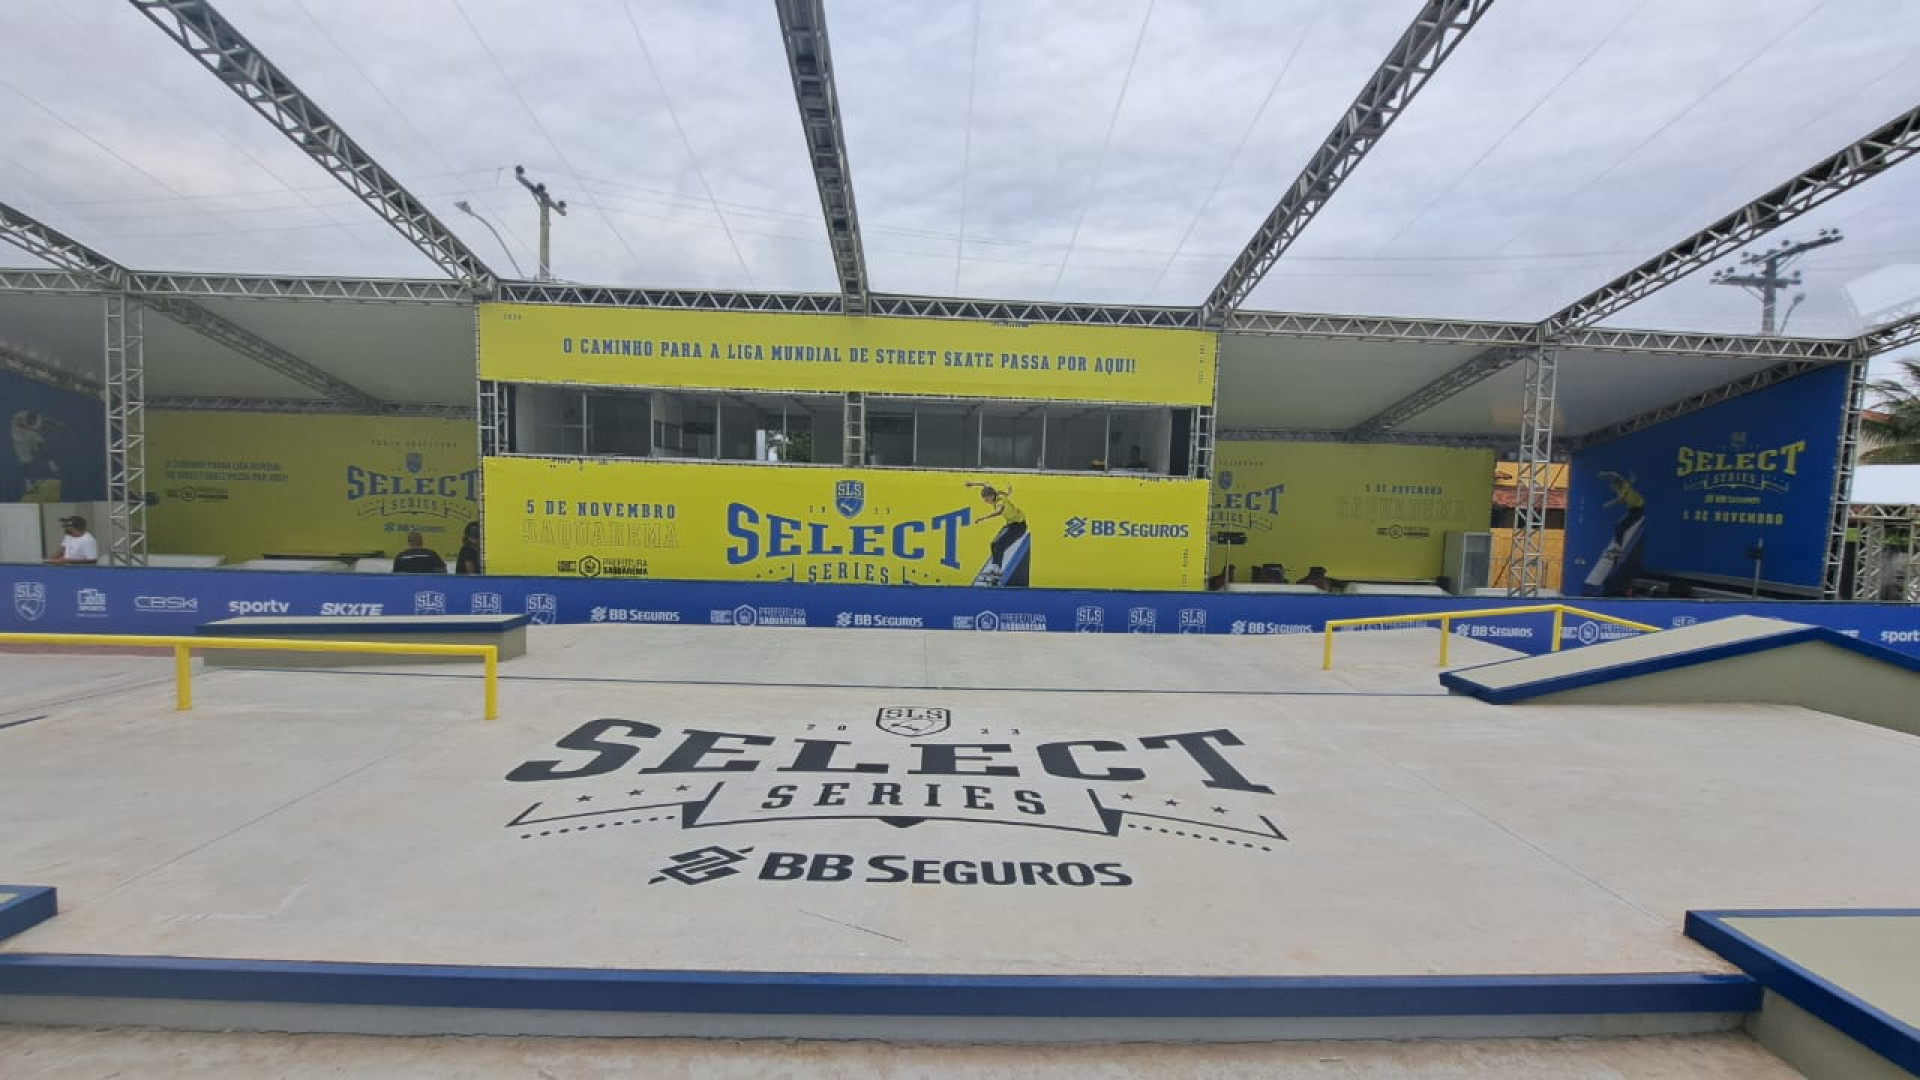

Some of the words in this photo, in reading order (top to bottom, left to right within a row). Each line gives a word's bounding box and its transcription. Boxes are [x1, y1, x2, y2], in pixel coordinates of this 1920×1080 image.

[563, 338, 573, 353] O
[580, 338, 653, 356] CAMINHO
[660, 341, 702, 358] PARA
[710, 343, 720, 359] A
[728, 344, 764, 361] LIGA
[771, 345, 842, 363] MUNDIAL
[850, 347, 869, 363] DE
[875, 348, 937, 366] STREET
[944, 350, 994, 368] SKATE
[1001, 353, 1050, 370] PASSA
[1057, 356, 1087, 372] POR
[1094, 356, 1136, 374] AQUI!
[1676, 441, 1806, 478] SELECT
[347, 465, 480, 501] SELECT
[837, 482, 863, 496] SLS
[527, 500, 535, 514] 5
[545, 500, 567, 516] DE
[578, 502, 676, 519] NOVEMBRO
[726, 502, 972, 570] SELECT
[1091, 520, 1116, 536] BB
[1119, 521, 1189, 538] SEGUROS
[808, 562, 889, 584] SERIES
[15, 584, 45, 598] SLS
[228, 600, 290, 615] sportv
[416, 592, 444, 608] SLS
[473, 594, 500, 608] SLS
[528, 595, 554, 610] SLS
[320, 602, 385, 616] SKXTE
[608, 609, 627, 621] BB
[1078, 607, 1102, 622] SLS
[1130, 609, 1154, 624] SLS
[854, 614, 872, 626] BB
[1471, 626, 1487, 637] BB
[884, 708, 943, 719] SLS
[505, 718, 1276, 795] SELECT
[761, 782, 1047, 815] SERIES
[757, 852, 854, 881] BB
[865, 854, 1133, 887] SEGUROS
